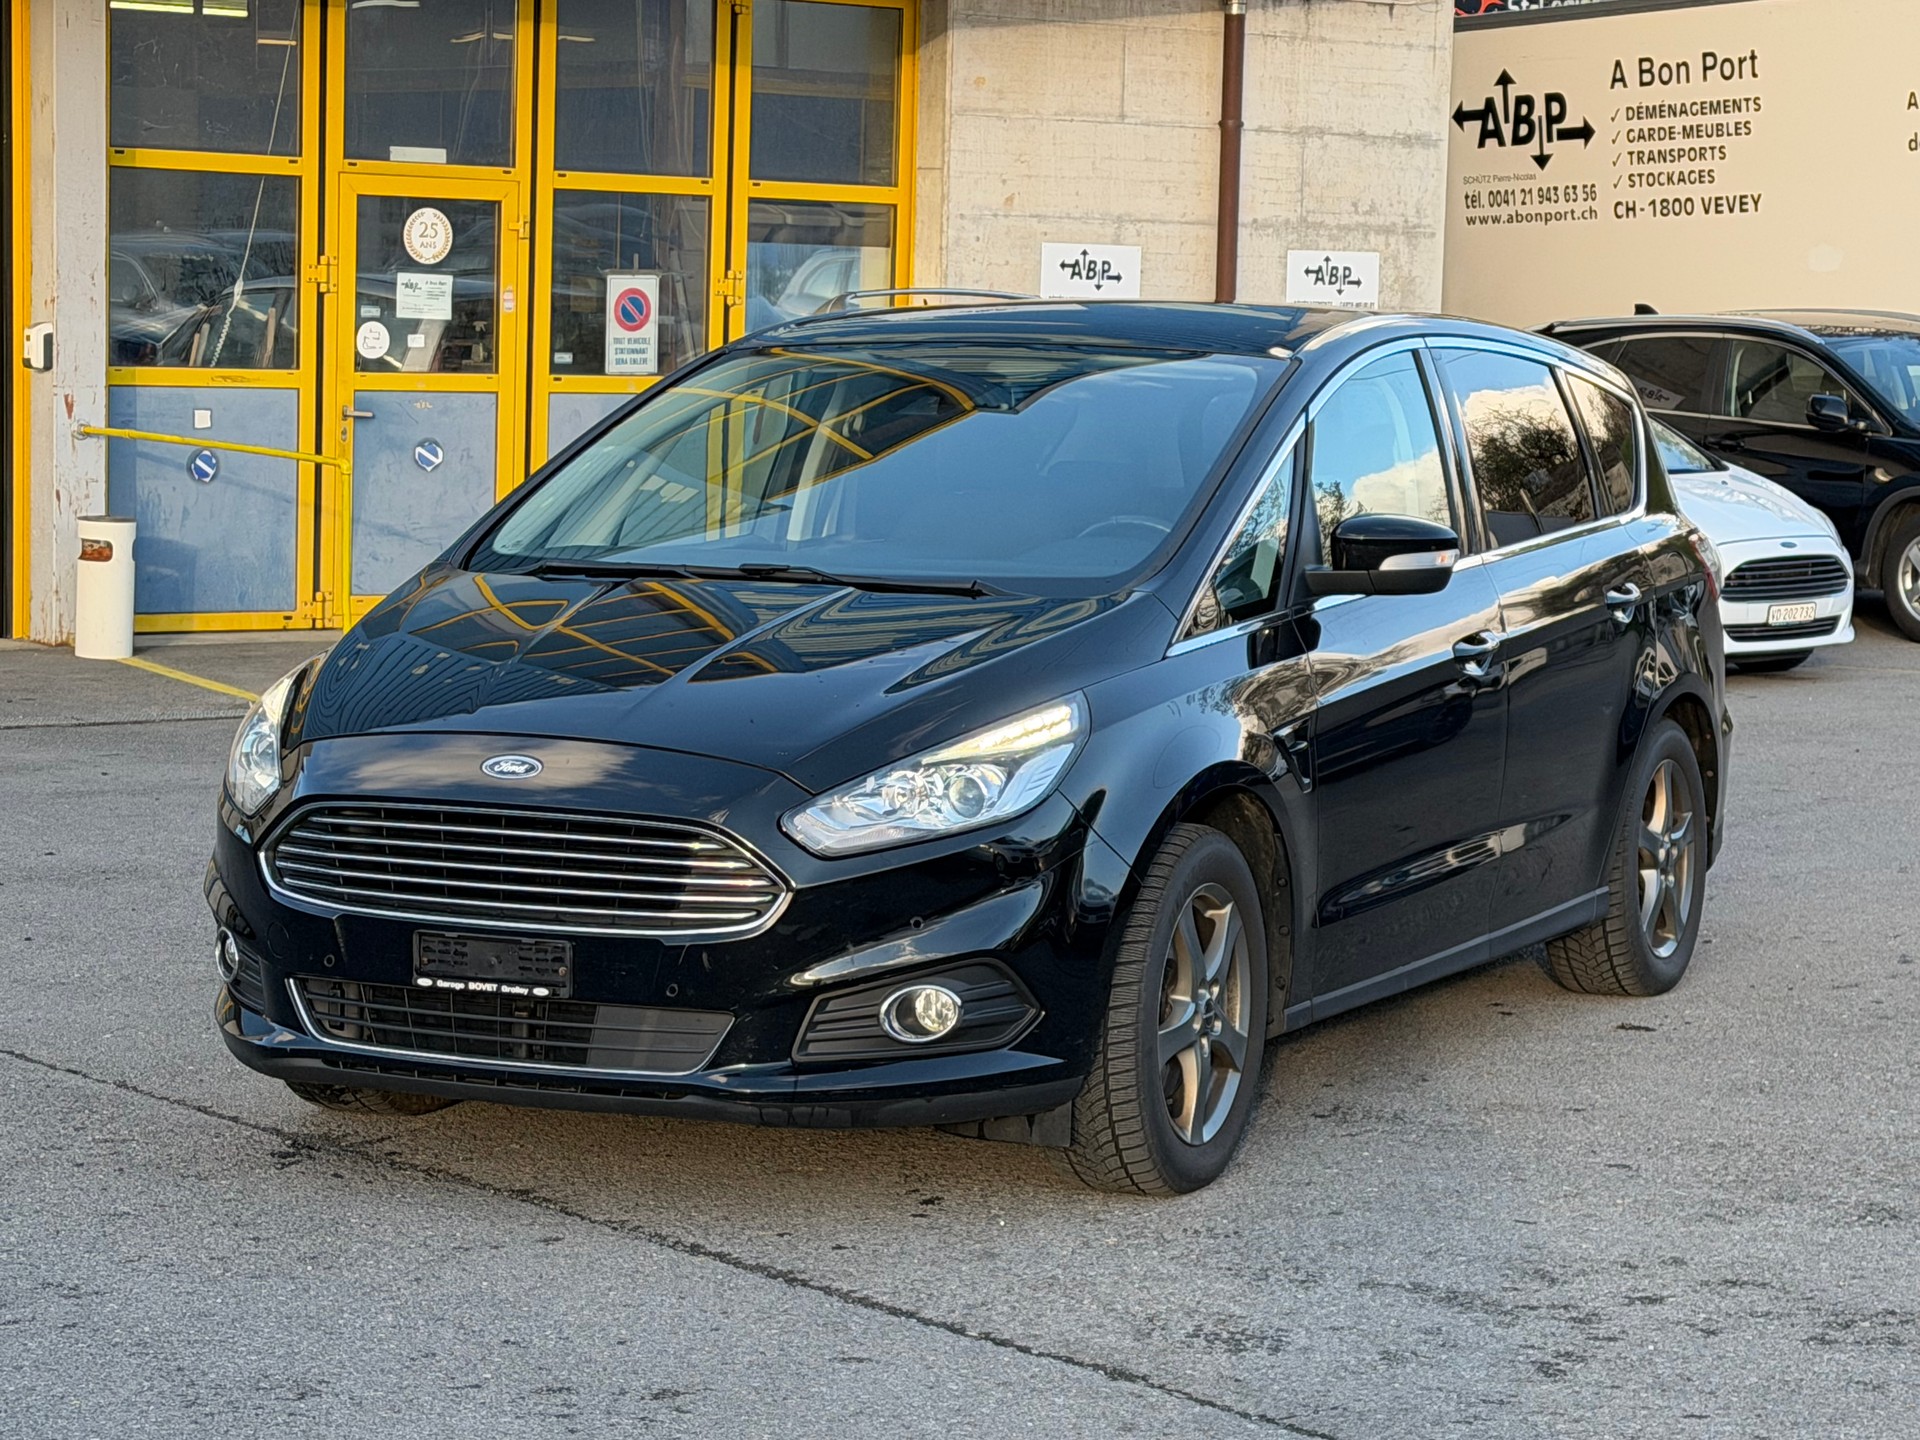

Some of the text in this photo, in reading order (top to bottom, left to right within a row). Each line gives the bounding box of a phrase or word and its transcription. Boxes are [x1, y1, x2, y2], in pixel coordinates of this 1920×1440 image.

[1609, 49, 1758, 89] A Bon Port
[1625, 96, 1762, 121] DÉMÉNAGEMENTS
[1477, 92, 1567, 149] ABP
[1626, 120, 1752, 143] GARDE-MEUBLES
[1627, 145, 1727, 166] TRANSPORTS
[1628, 169, 1716, 188] STOCKAGES
[1464, 183, 1597, 209] tél. 0041 21 943 63 56
[1701, 193, 1762, 215] VEVEY
[1465, 206, 1598, 226] www.abonport.ch
[418, 222, 438, 238] 25
[419, 241, 437, 249] ANS
[1070, 259, 1111, 280] ABP
[1313, 265, 1352, 285] ABP
[493, 759, 529, 773] Ford
[436, 979, 465, 990] Garage
[468, 982, 498, 991] BOVET
